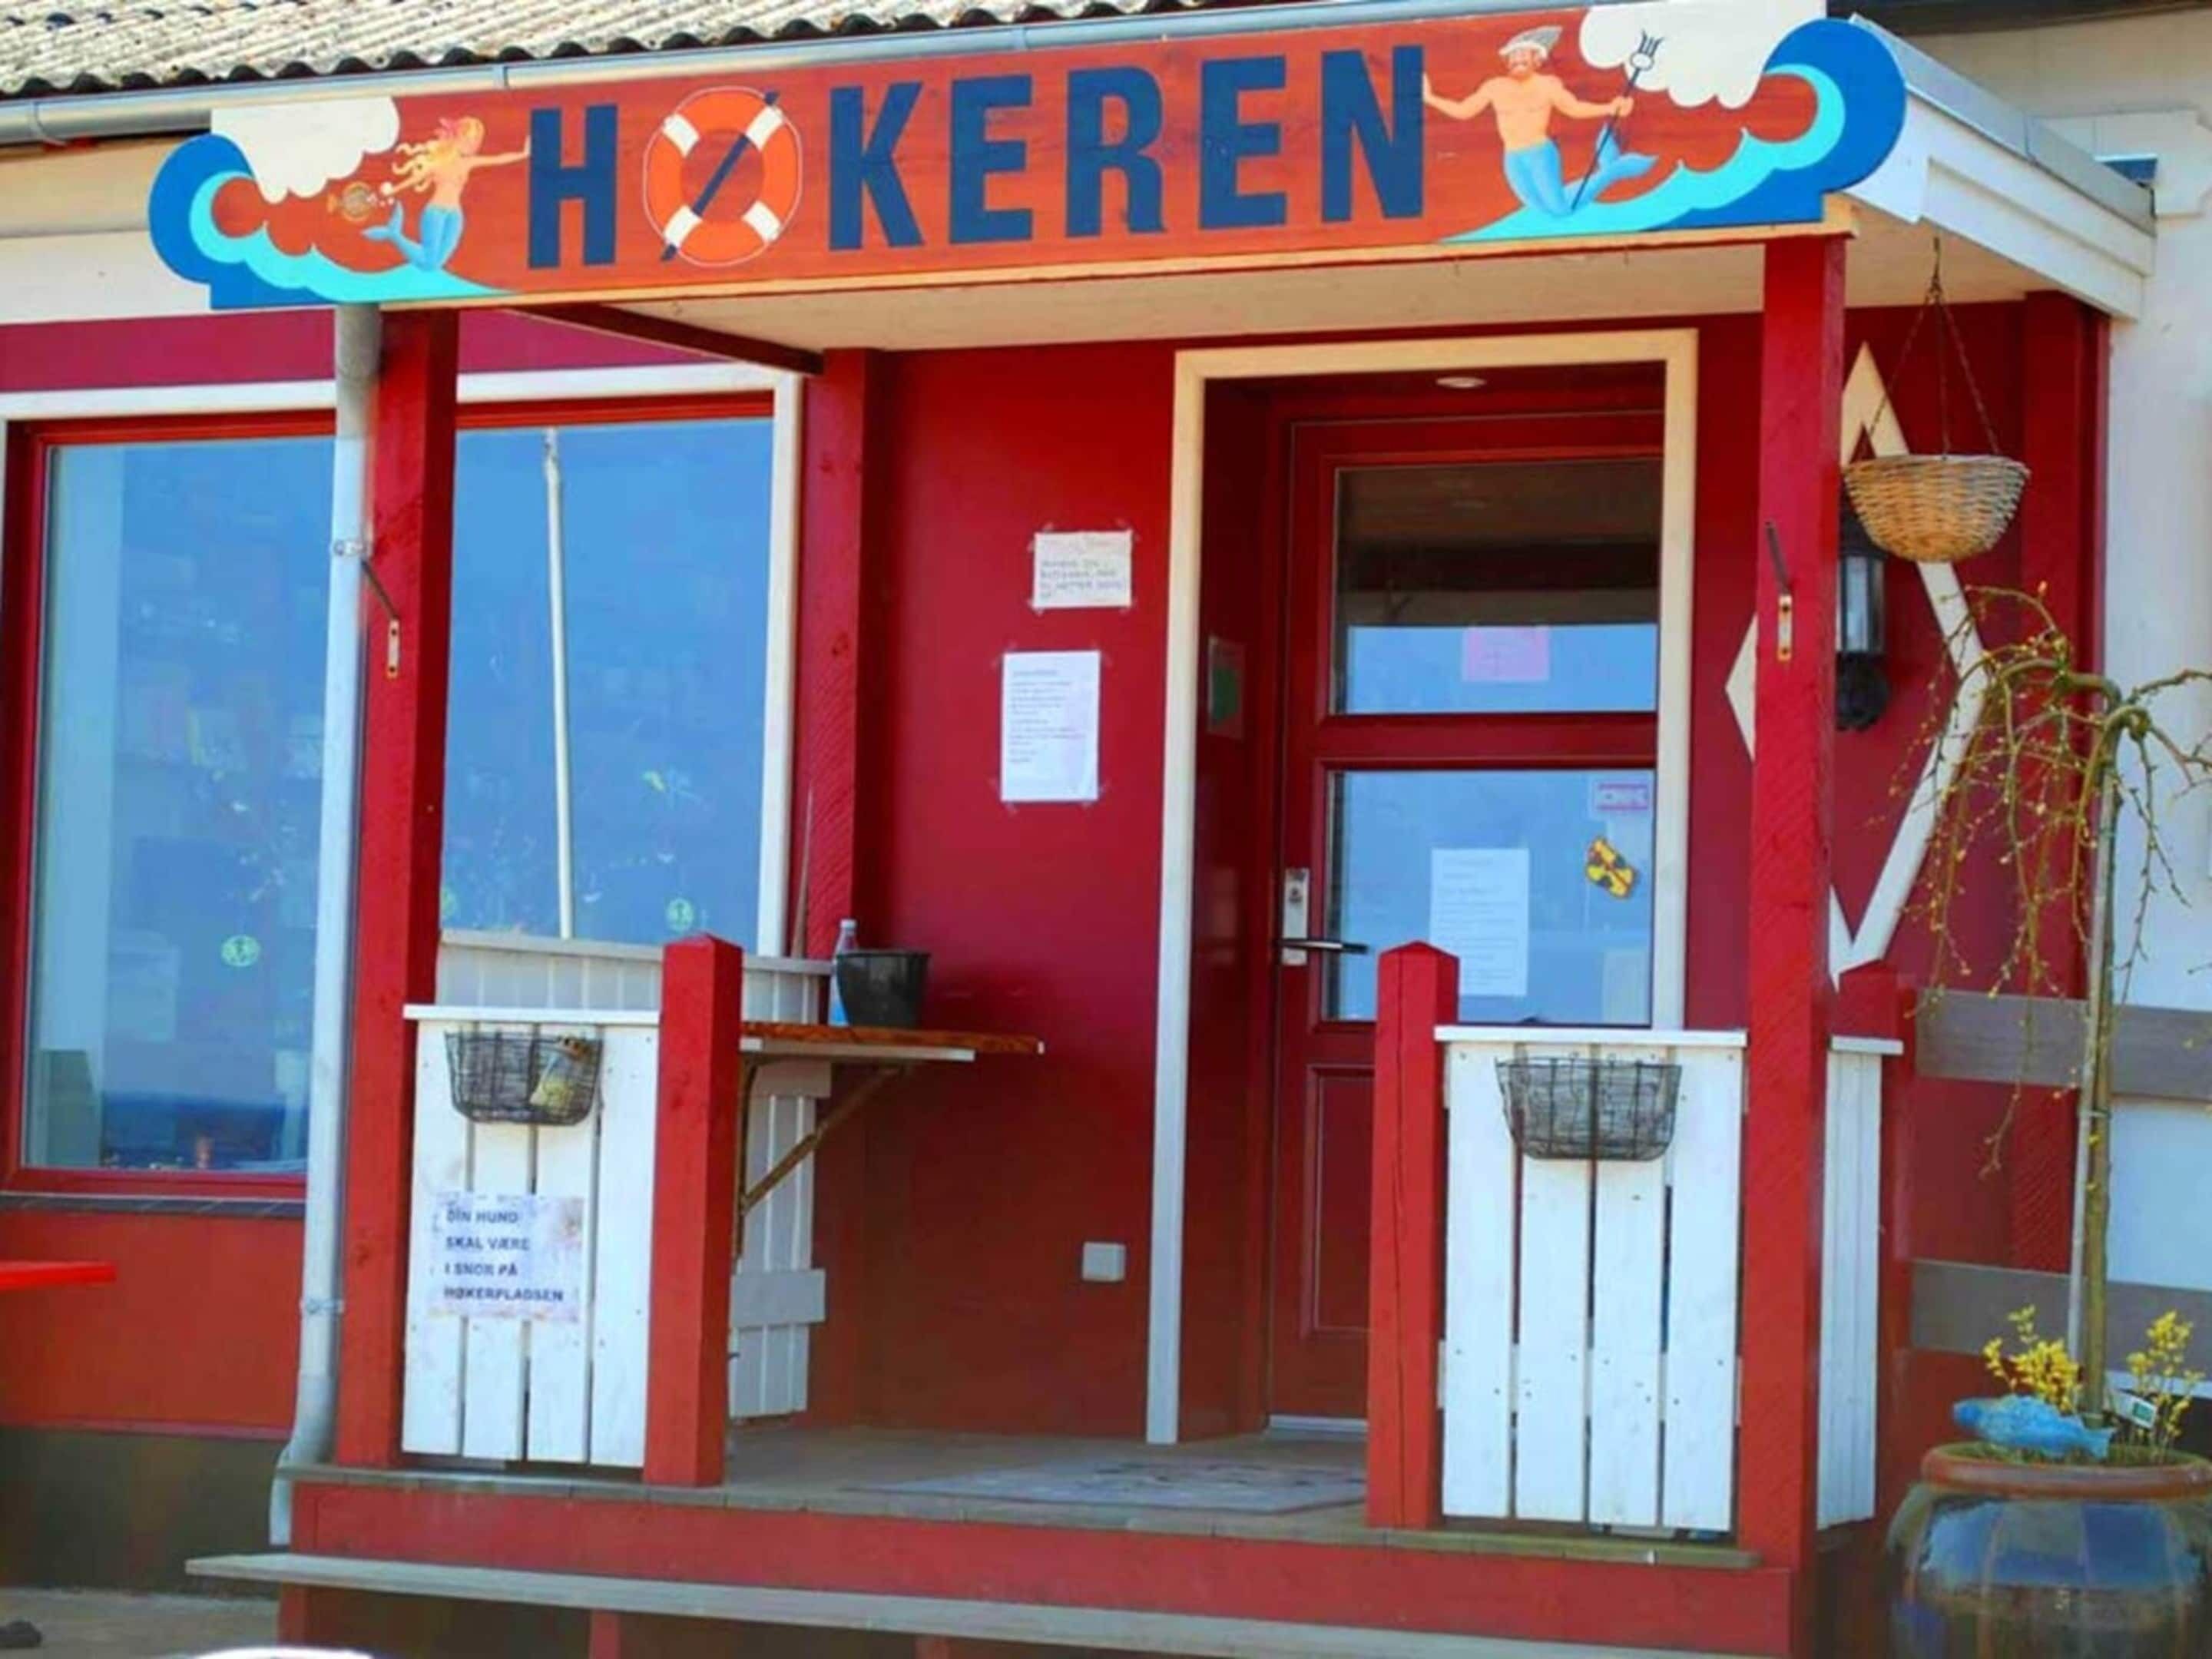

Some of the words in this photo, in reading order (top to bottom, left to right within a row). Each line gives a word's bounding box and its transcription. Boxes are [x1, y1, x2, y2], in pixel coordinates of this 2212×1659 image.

[527, 45, 1426, 270] HØKEREN
[447, 1209, 472, 1222] DIN
[476, 1210, 518, 1224] HUND
[446, 1237, 483, 1250] SKAL
[488, 1238, 530, 1251] VÆRE
[454, 1263, 494, 1276] SNOR
[498, 1262, 518, 1276] PÅ
